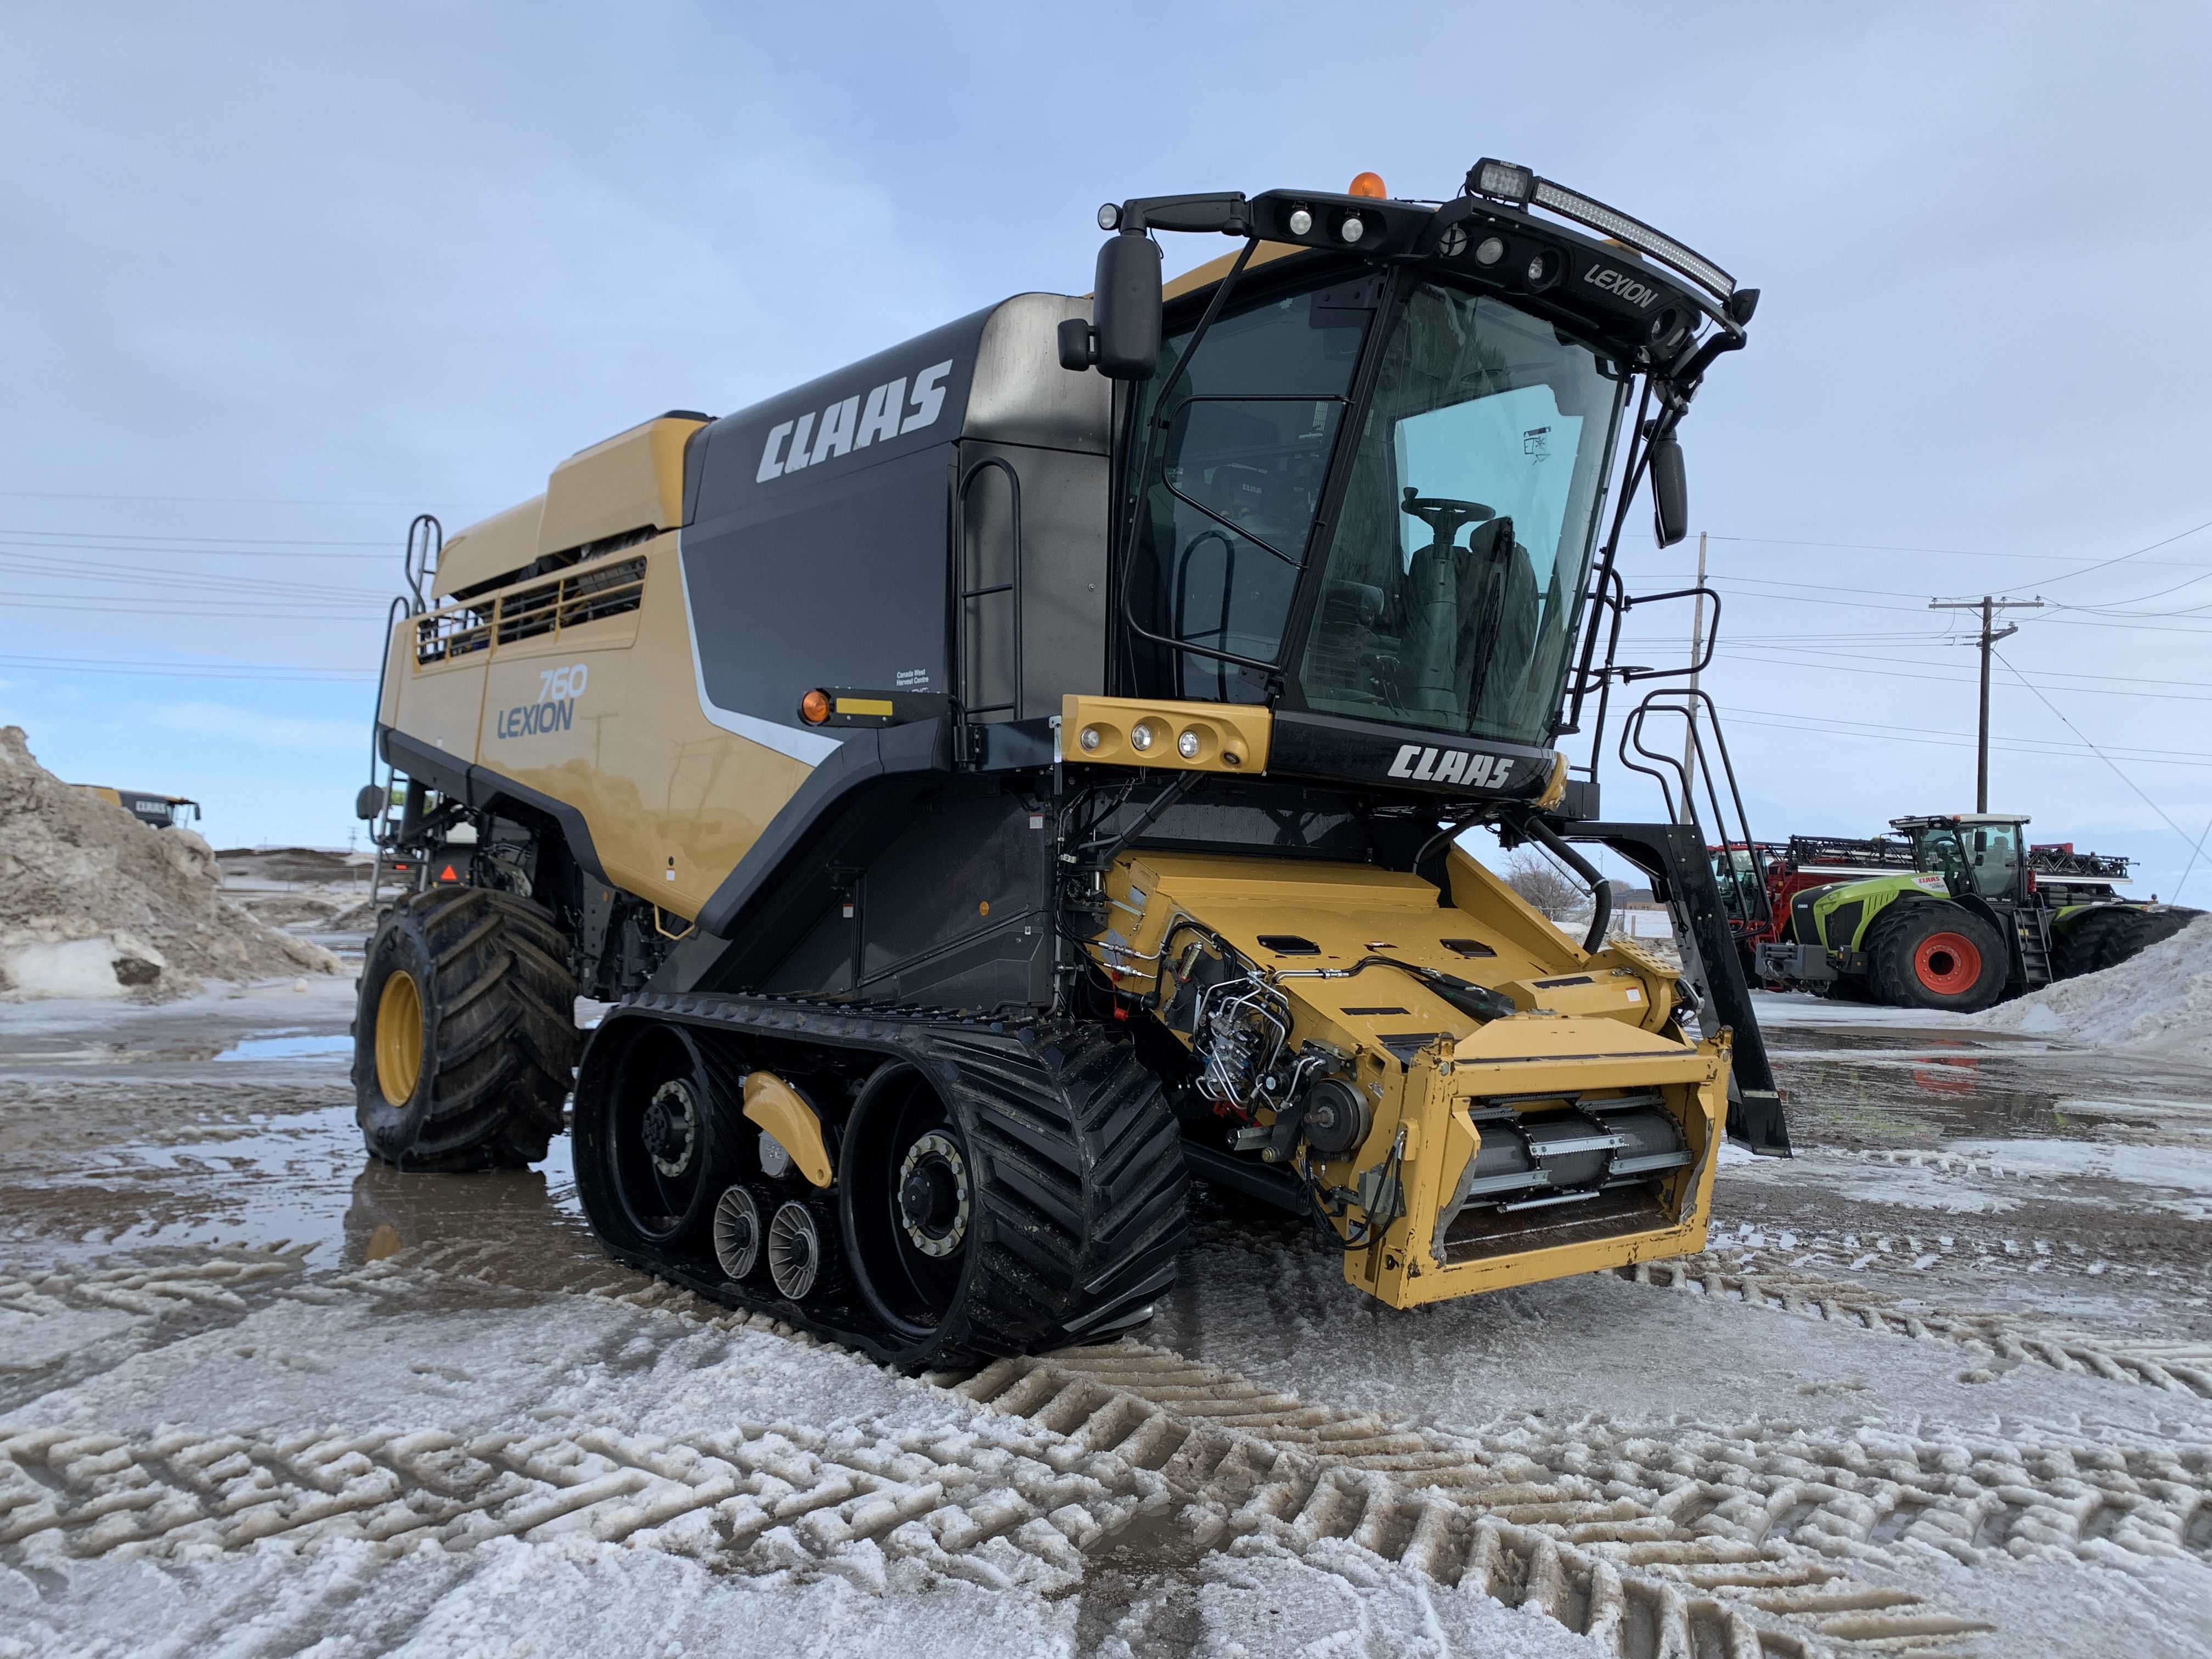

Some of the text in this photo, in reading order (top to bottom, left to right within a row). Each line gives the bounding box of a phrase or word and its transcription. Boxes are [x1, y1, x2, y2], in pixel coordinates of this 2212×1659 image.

[1583, 263, 1660, 308] LEXION
[755, 358, 953, 484] CLAAS
[537, 663, 588, 703] 760
[896, 668, 926, 679] Canada West
[896, 676, 929, 686] Harvest Centre
[497, 698, 574, 740] LEXION
[1387, 744, 1515, 789] CLAAS
